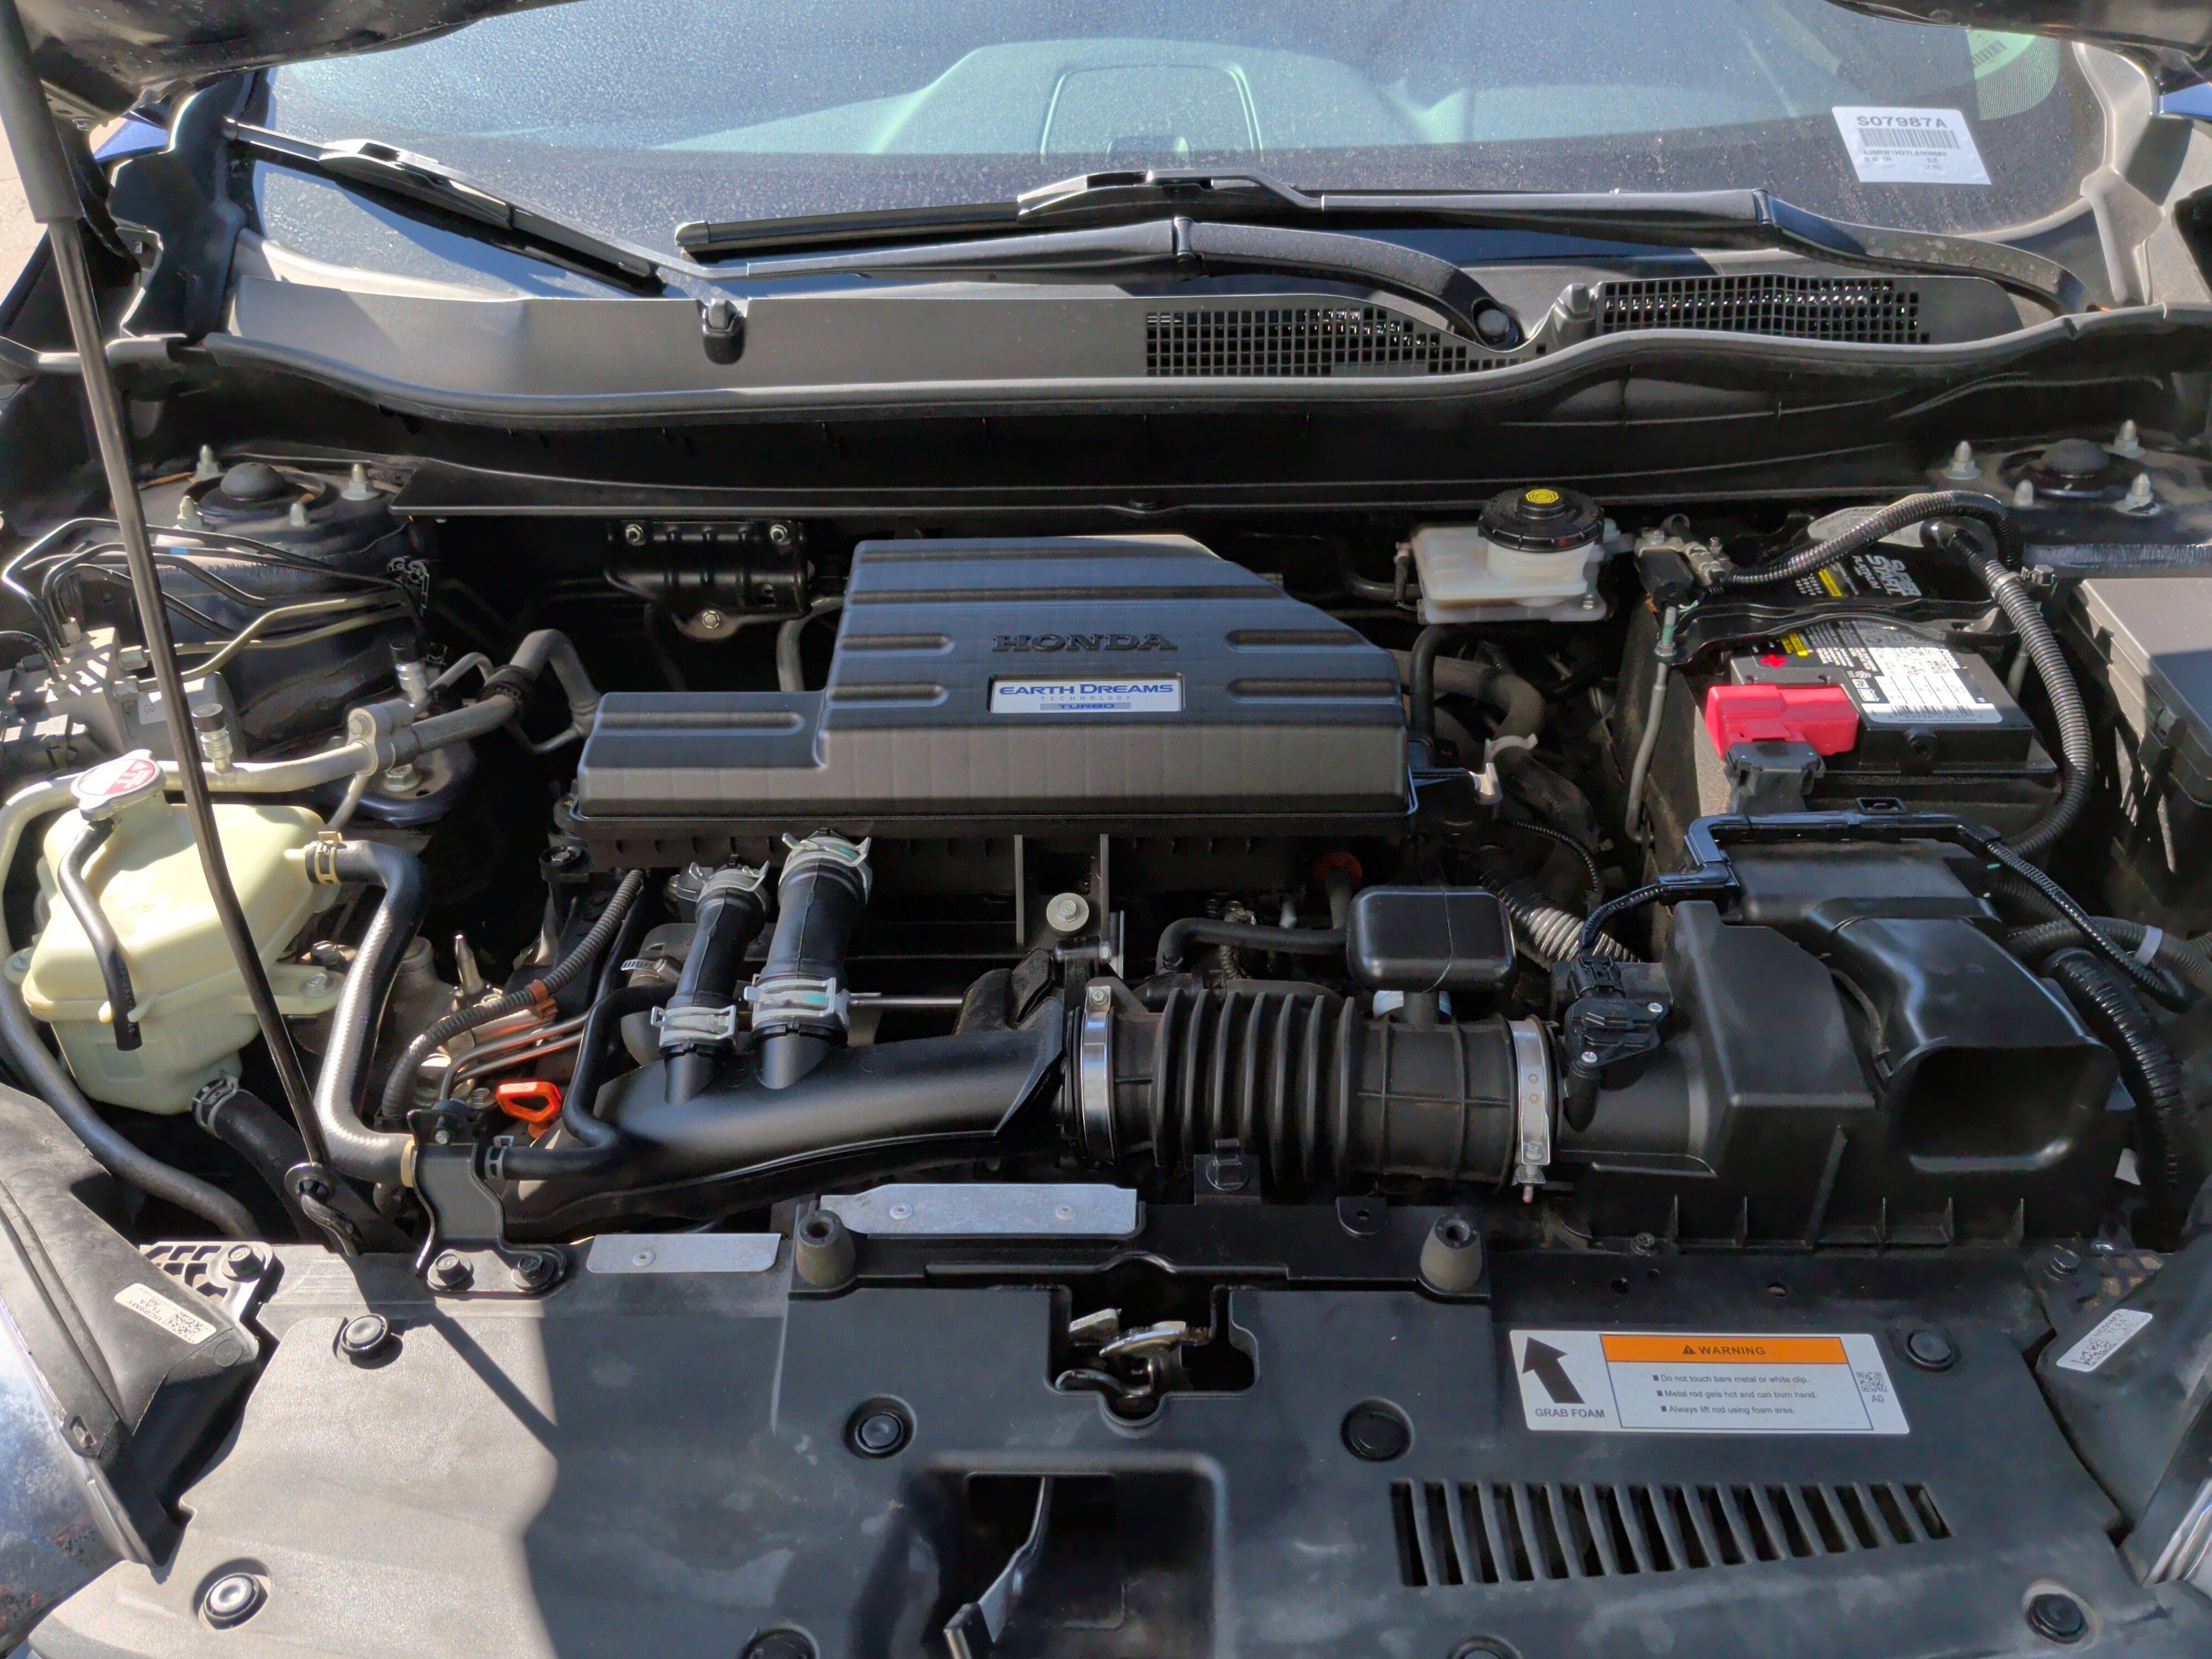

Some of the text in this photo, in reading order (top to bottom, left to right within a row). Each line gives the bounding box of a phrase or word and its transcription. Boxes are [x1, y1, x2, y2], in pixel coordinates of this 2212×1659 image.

[1865, 554, 1908, 596] START
[992, 634, 1178, 653] HONDA
[999, 684, 1174, 695] EARTH DREAMS
[1698, 1346, 1766, 1355] WARNING
[1793, 1376, 1809, 1384] clip.
[1535, 1408, 1605, 1418] GRAB FOAM
[1669, 1406, 1698, 1415] Always
[1728, 1407, 1750, 1415] using
